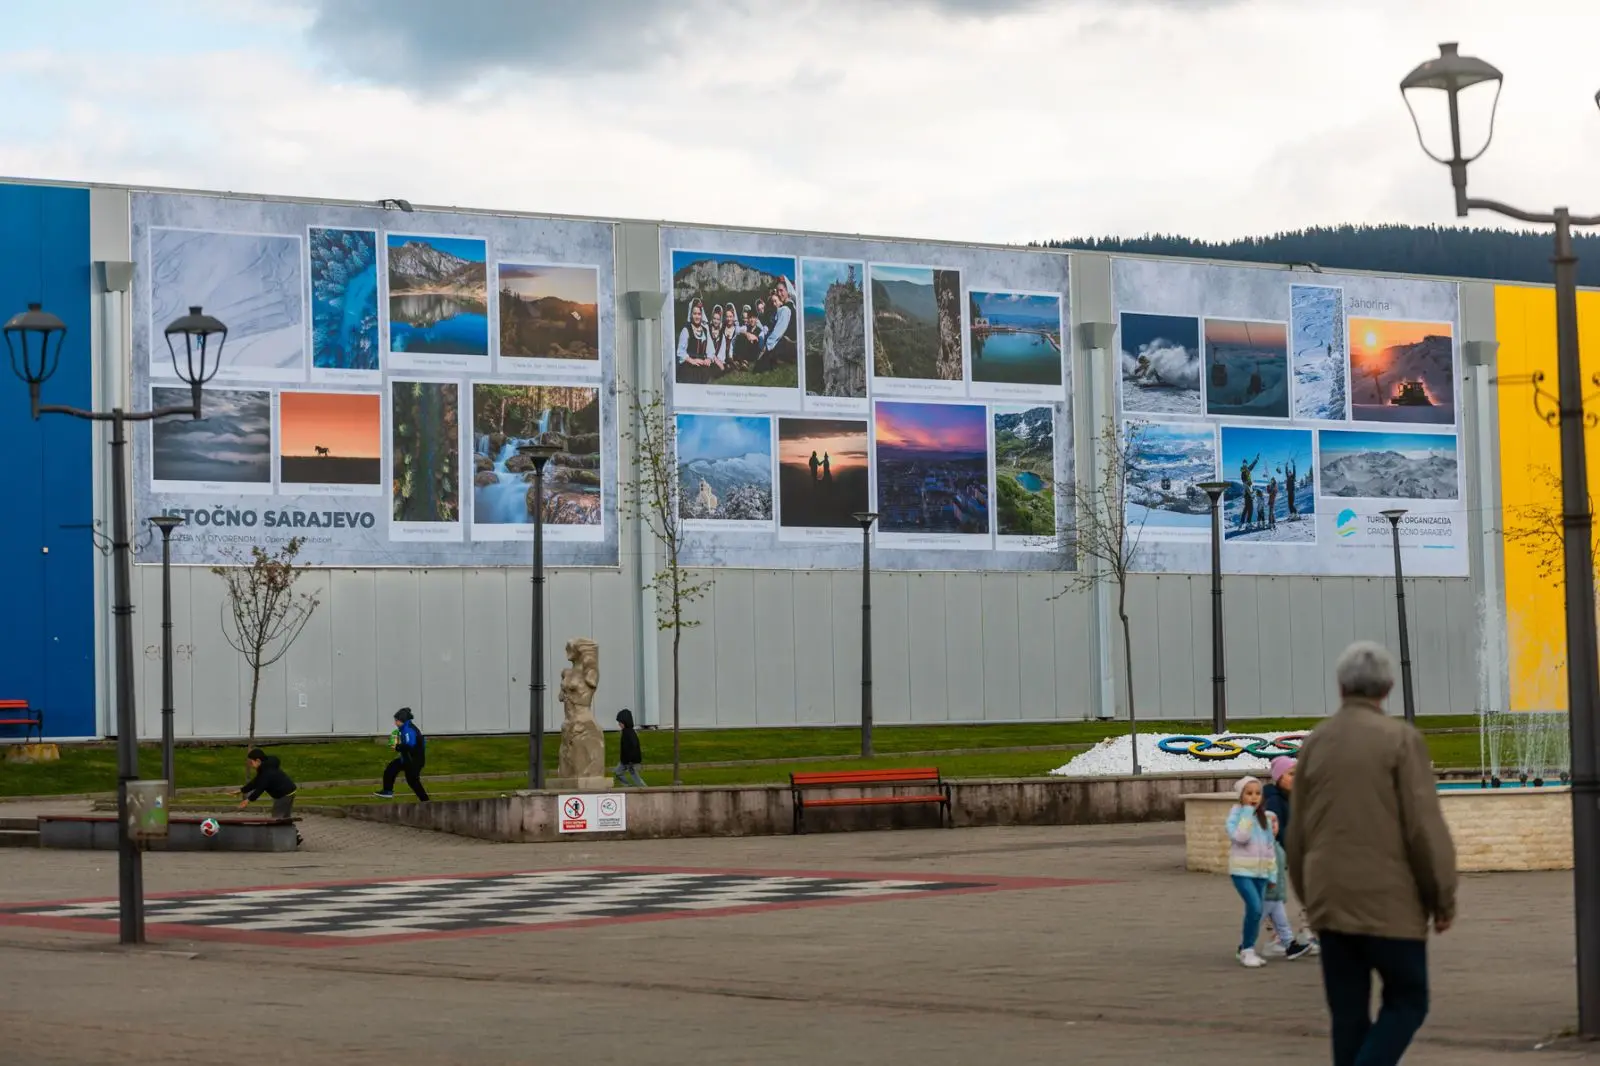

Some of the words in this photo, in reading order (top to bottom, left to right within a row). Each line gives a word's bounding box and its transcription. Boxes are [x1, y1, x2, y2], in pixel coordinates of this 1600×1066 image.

[1349, 297, 1390, 311] Jahorina
[263, 510, 376, 529] SARAJEVO
[1405, 516, 1452, 525] ORGANIZACIJA
[1419, 528, 1453, 537] SARAJEVO
[207, 534, 257, 544] OTVORENOM
